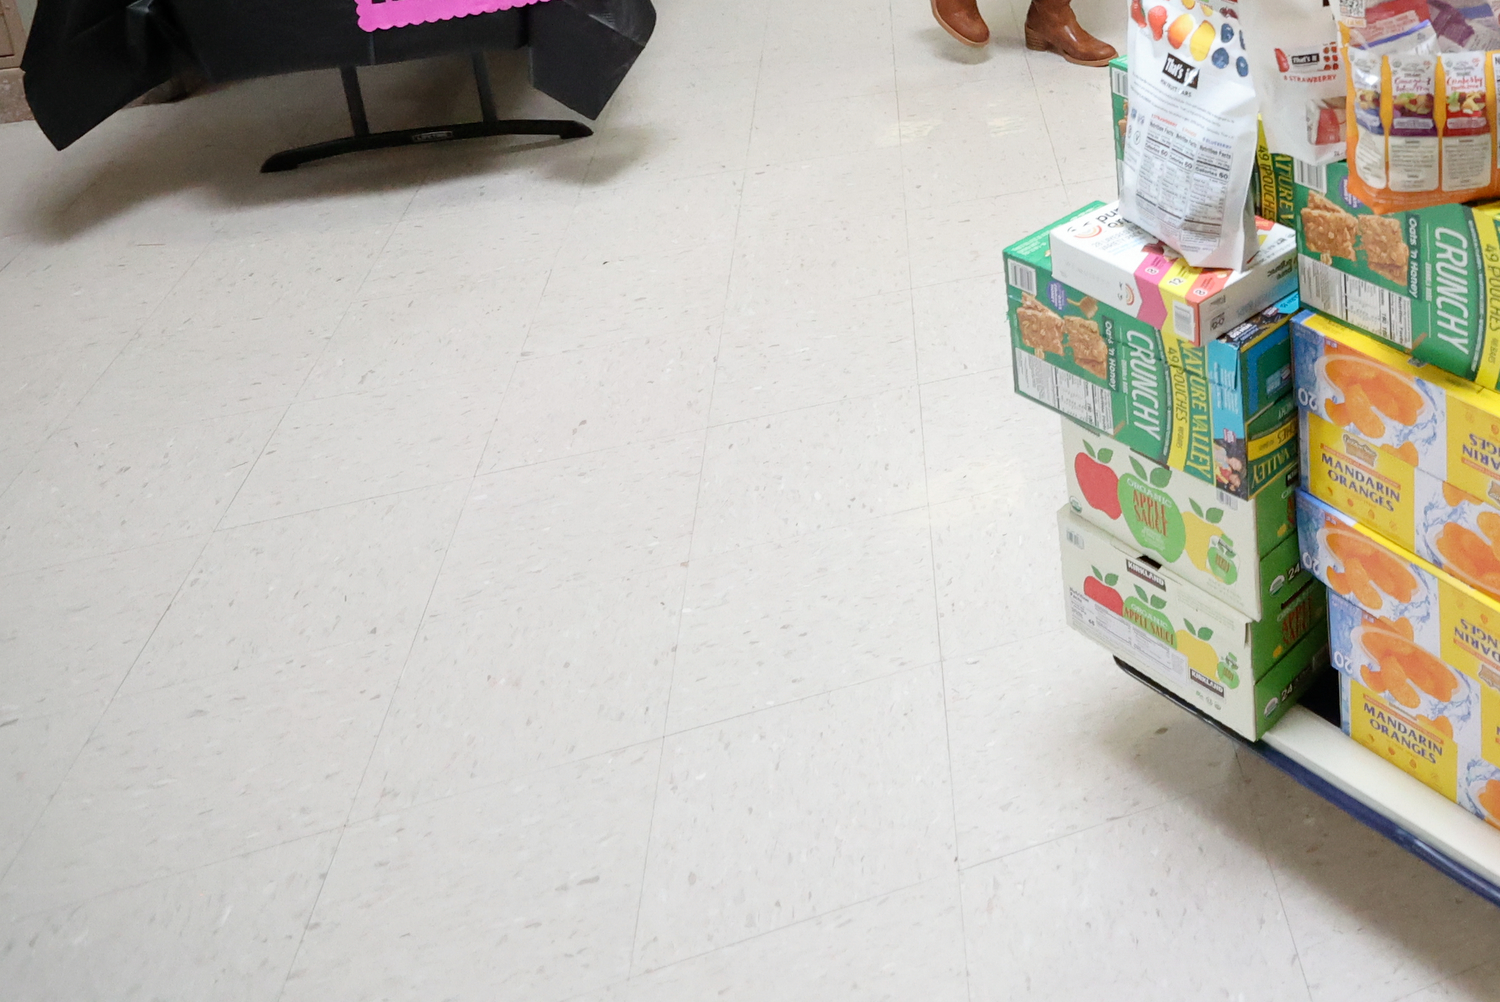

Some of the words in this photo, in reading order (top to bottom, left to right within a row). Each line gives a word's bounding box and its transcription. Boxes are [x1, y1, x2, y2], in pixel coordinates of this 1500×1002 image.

[1163, 58, 1184, 79] That's
[1289, 74, 1337, 83] STRAWBERRY
[1200, 145, 1218, 156] Nutrition
[1218, 151, 1232, 159] Facts
[1258, 146, 1269, 160] 49
[1195, 166, 1218, 178] Calories
[1219, 171, 1229, 180] 60
[1273, 155, 1293, 210] ATURE
[1409, 217, 1419, 238] Oats
[1486, 243, 1499, 261] 49
[1434, 227, 1468, 354] CRUNCHY
[1103, 321, 1113, 343] Oats
[1108, 358, 1117, 390] Honey
[1166, 347, 1179, 362] 49
[1125, 330, 1160, 440] CRUNCHY
[1169, 364, 1187, 425] POUCHES
[1298, 387, 1319, 411] 20
[1187, 414, 1208, 479] VALLEY
[1251, 449, 1291, 485] VALLEY
[1321, 452, 1401, 501] MANDARIN
[1126, 476, 1173, 507] ORGANIC
[1132, 488, 1169, 520] APPLE
[1327, 469, 1394, 512] ORANGES
[1134, 510, 1169, 539] SAUCE
[1126, 560, 1167, 589] KIRKLAND
[1287, 562, 1301, 583] 24
[1301, 550, 1321, 576] 20
[1334, 649, 1354, 674] 20
[1190, 669, 1225, 696] KIRKLAND
[1281, 681, 1294, 702] 24
[1363, 701, 1444, 758] MANDARIN
[1369, 717, 1437, 765] ORANGES
